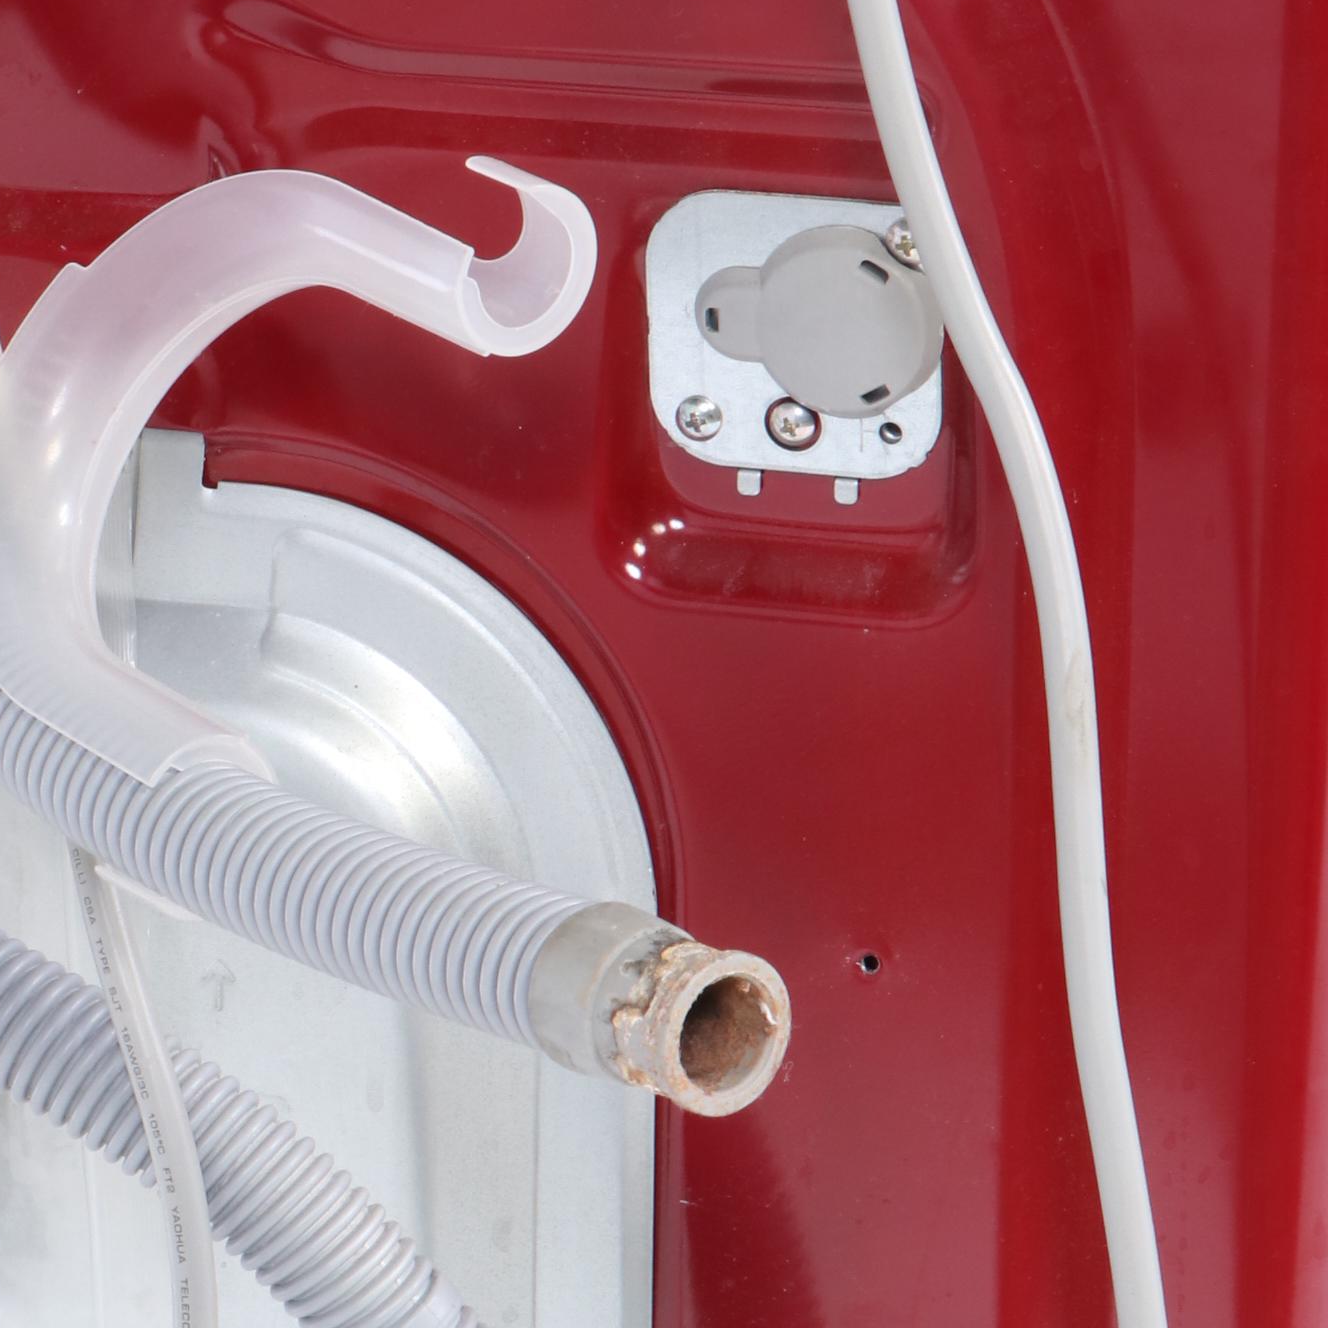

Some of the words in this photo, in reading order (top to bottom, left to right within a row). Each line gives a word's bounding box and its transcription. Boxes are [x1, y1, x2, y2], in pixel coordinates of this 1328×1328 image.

[95, 936, 111, 974] TYPE
[109, 986, 123, 1013] SJT
[171, 1206, 187, 1264] YAOHUA
